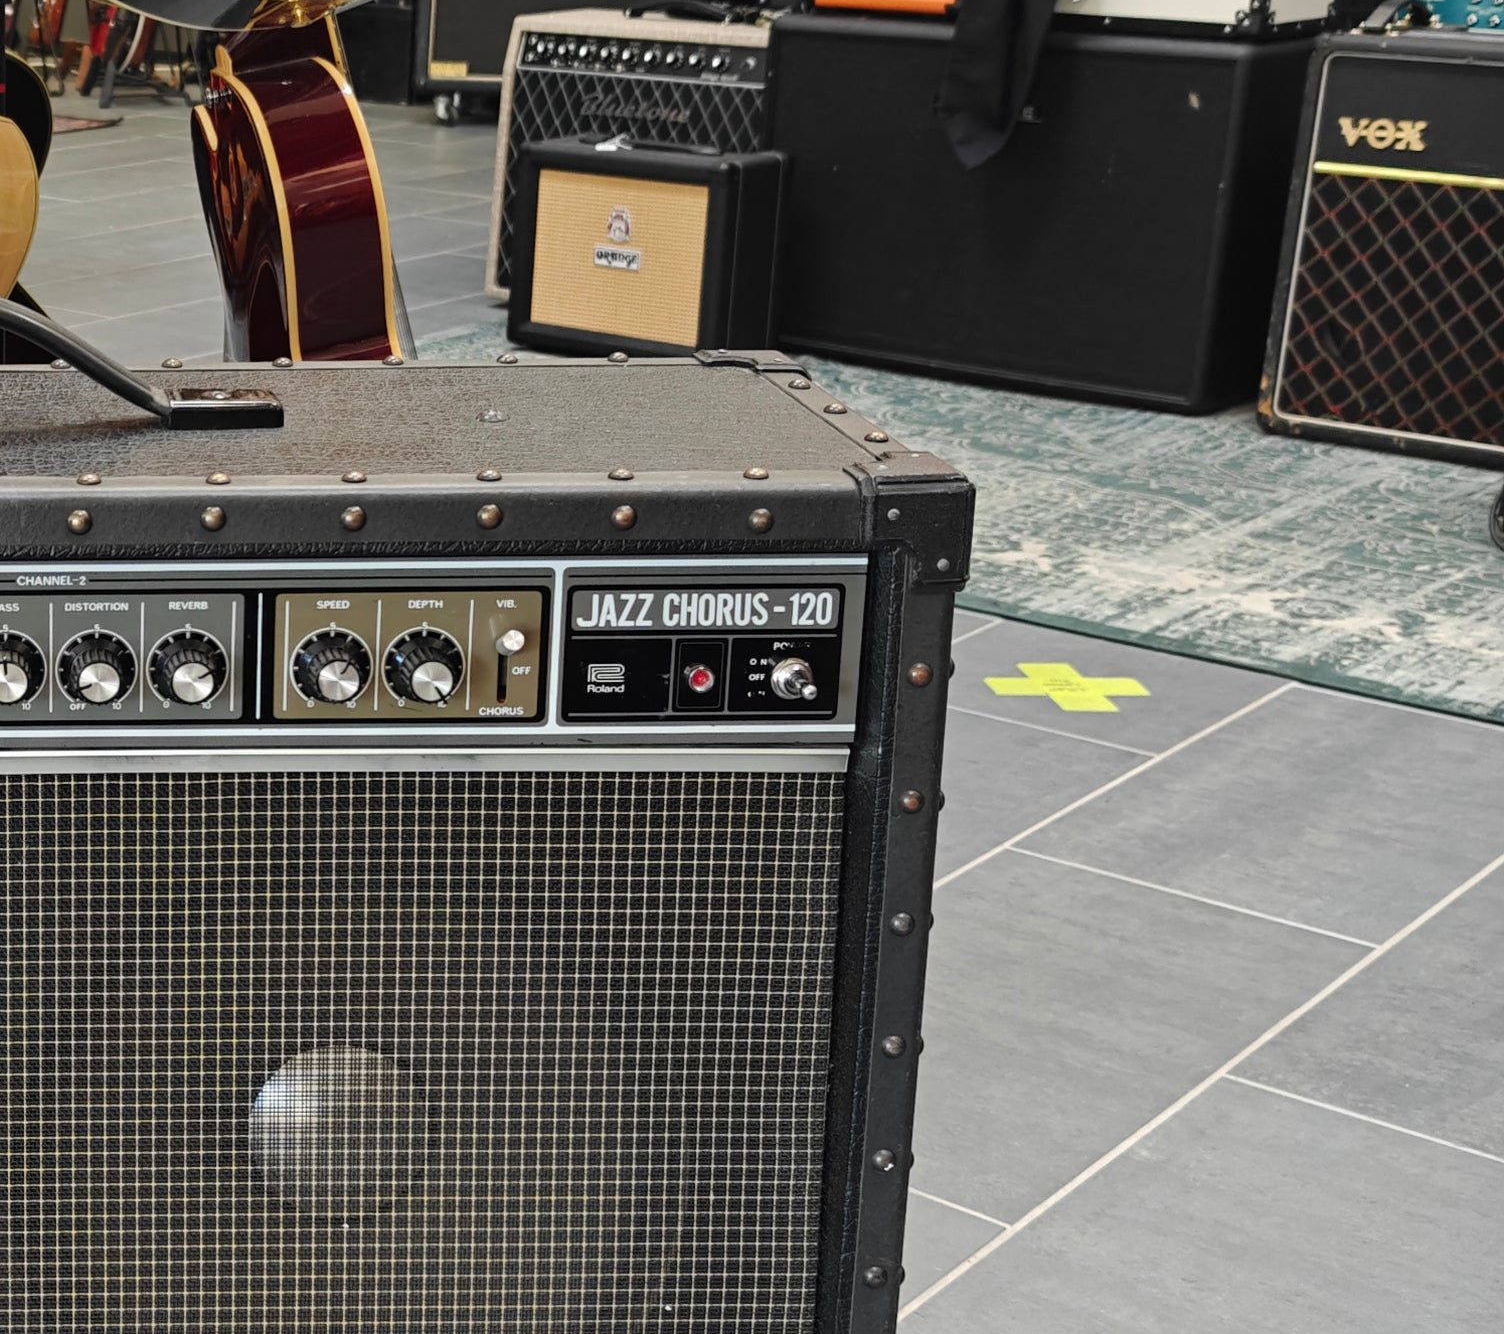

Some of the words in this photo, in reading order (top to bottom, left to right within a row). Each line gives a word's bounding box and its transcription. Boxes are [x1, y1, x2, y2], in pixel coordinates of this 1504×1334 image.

[1338, 116, 1430, 152] VOX
[16, 575, 87, 586] CHANNEL-2
[64, 602, 129, 612] DISTORTION
[168, 601, 208, 610] REVERB
[316, 600, 350, 610] SPEED
[408, 599, 444, 609] DEPTH
[496, 599, 518, 609] VIB.
[576, 593, 654, 627] JAZZ
[512, 666, 532, 675] OFF
[748, 673, 765, 681] OFF
[587, 684, 625, 693] Roland
[22, 702, 31, 710] 10
[69, 703, 86, 711] OFF
[113, 702, 122, 710] 10
[202, 700, 212, 709] 10
[347, 700, 356, 708] 10
[479, 707, 524, 716] CHORUS
